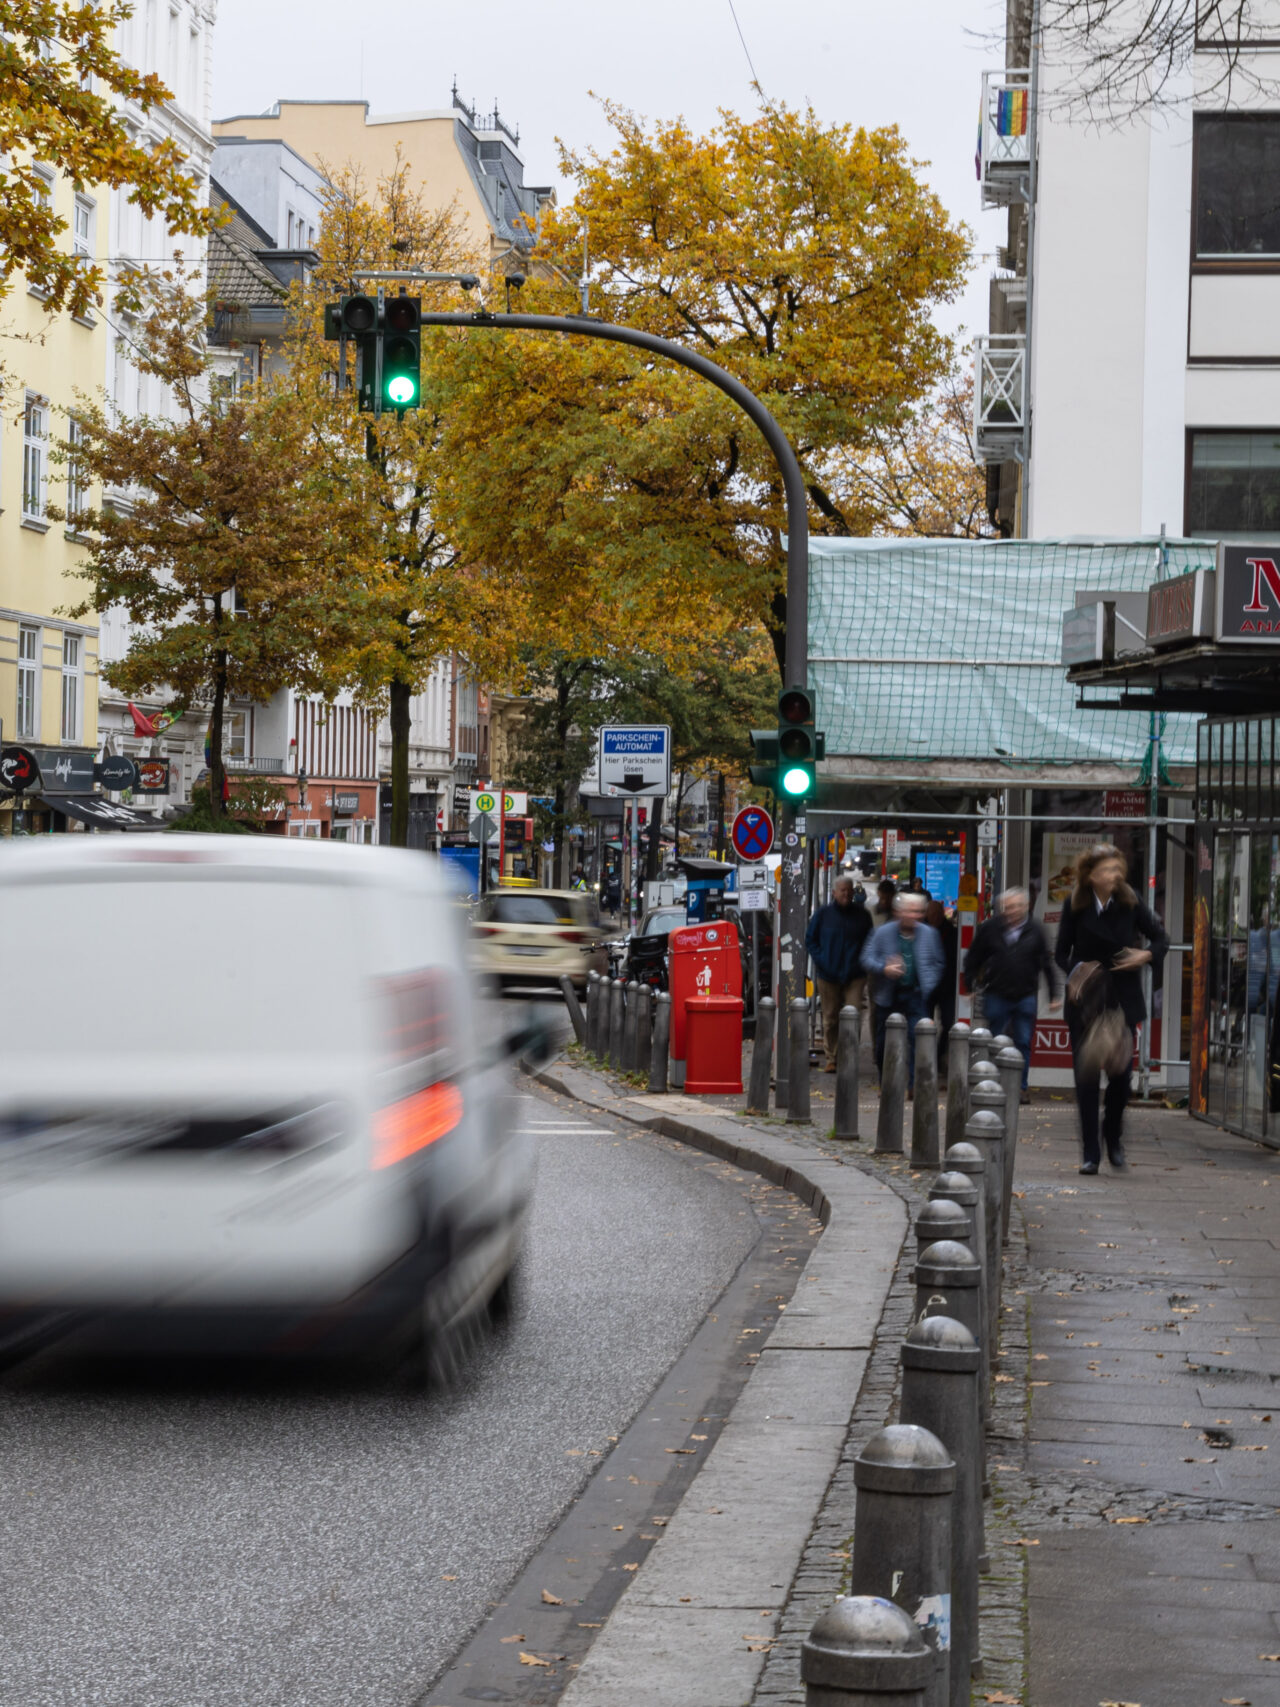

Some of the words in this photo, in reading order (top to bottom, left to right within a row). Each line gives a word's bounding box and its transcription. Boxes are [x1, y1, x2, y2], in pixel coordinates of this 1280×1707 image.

[606, 733, 662, 742] PARKSCHEIN-
[615, 742, 653, 751] AUTOMAT
[605, 756, 619, 764] Hier
[623, 756, 662, 764] Parkschein
[689, 892, 697, 908] P
[1035, 1030, 1071, 1048] NU
